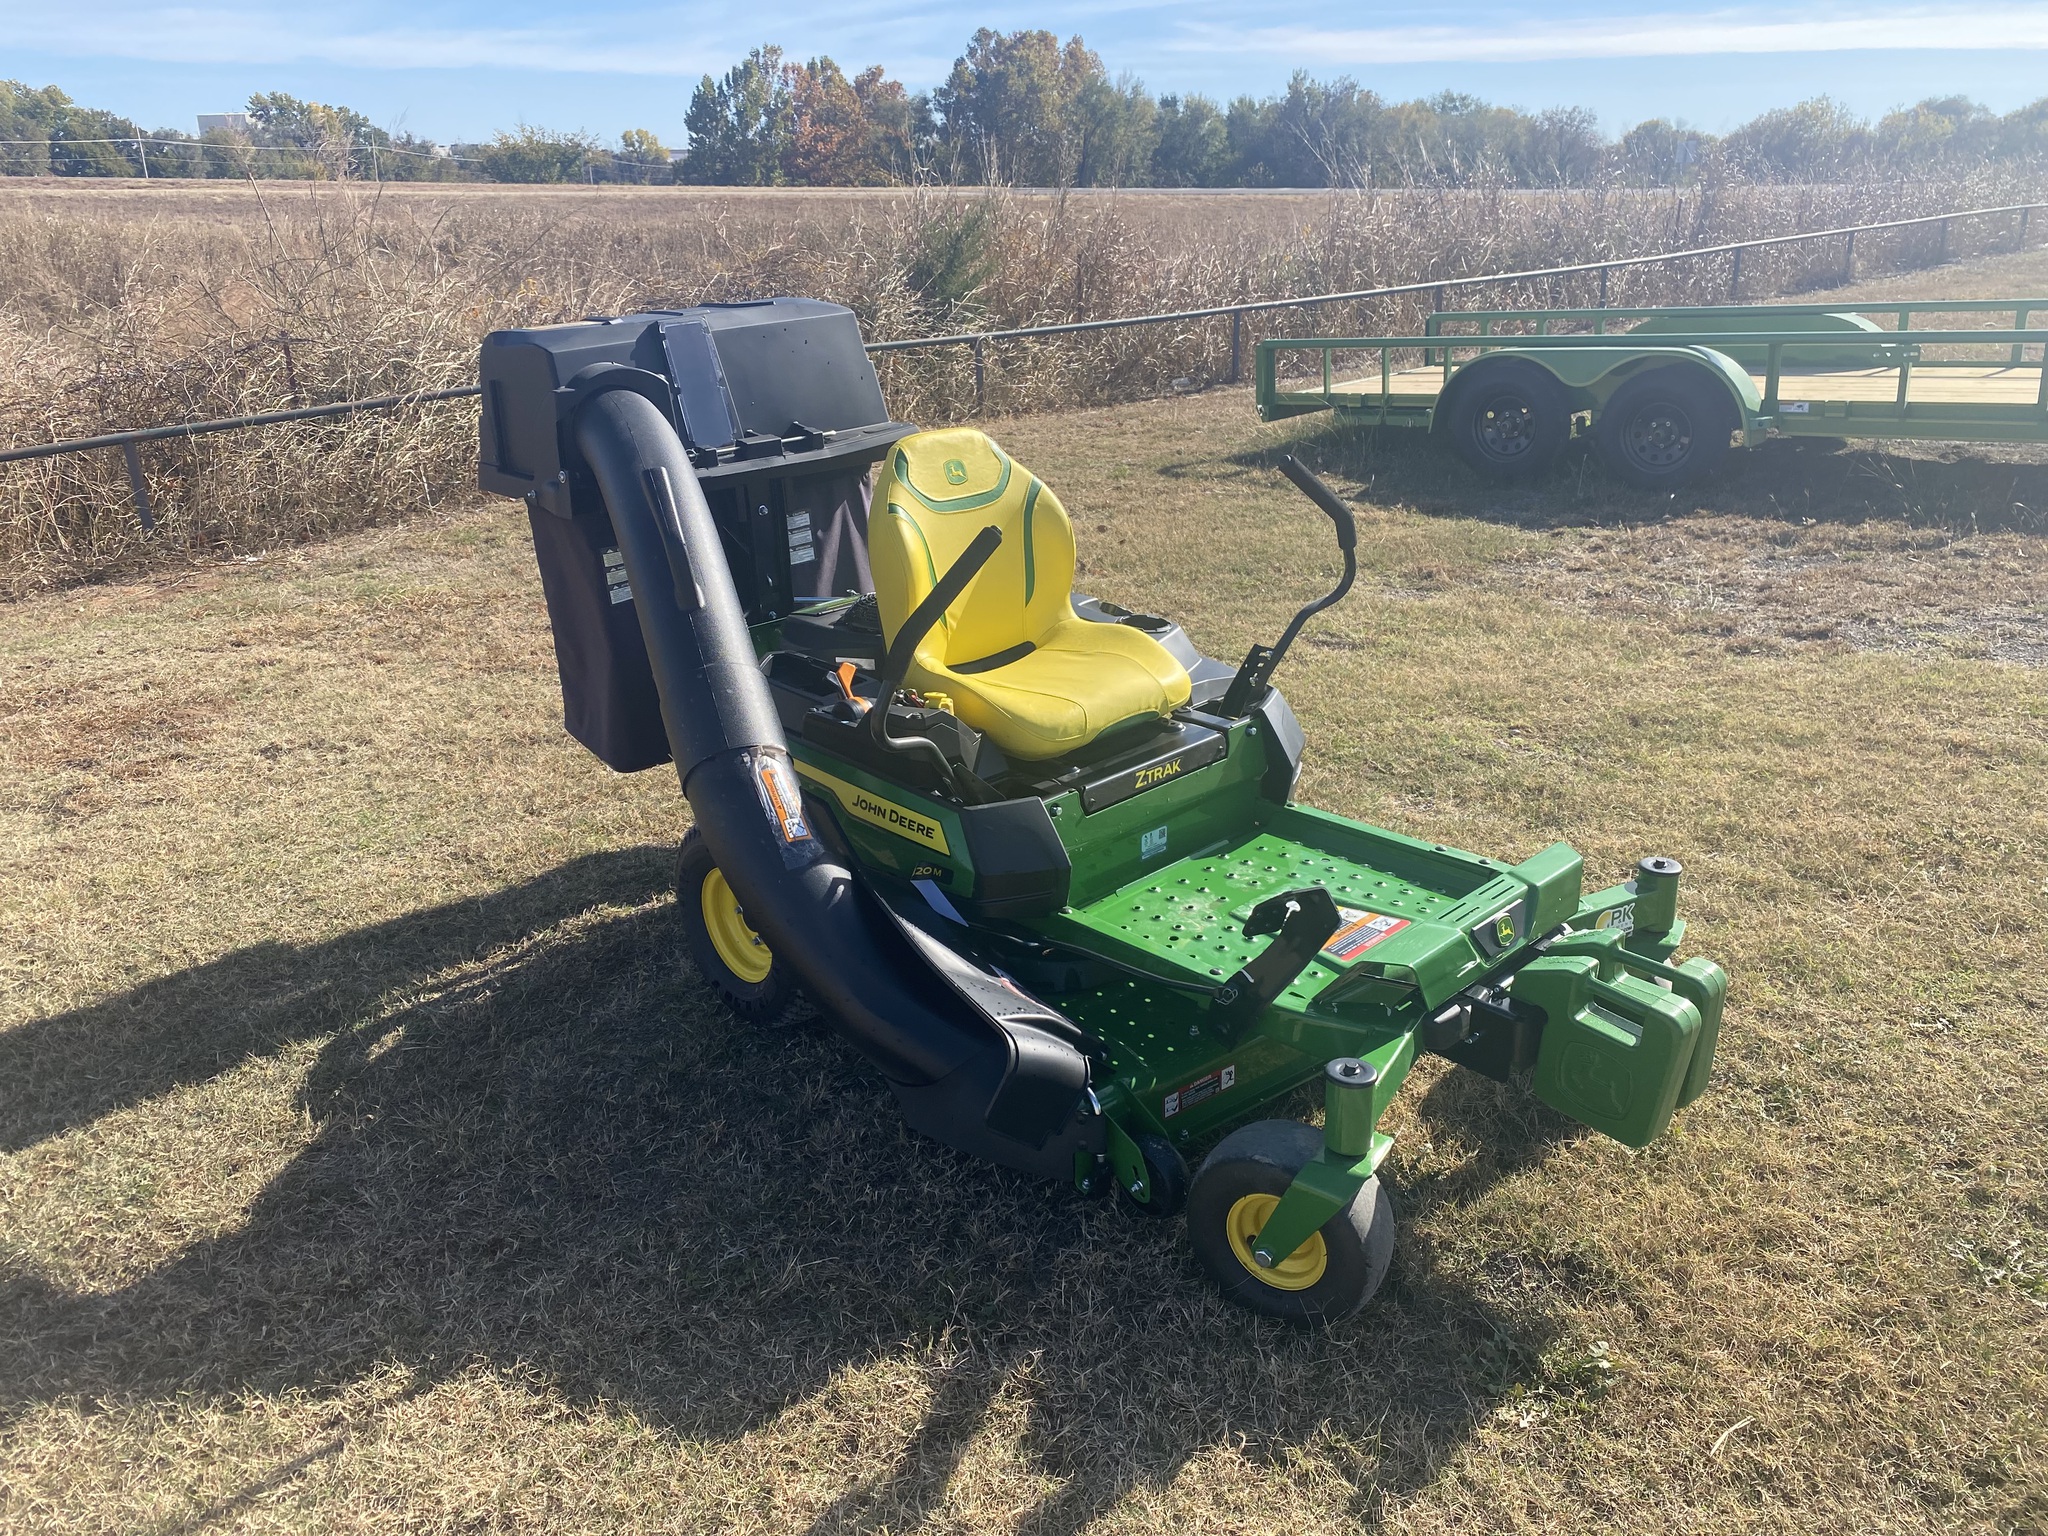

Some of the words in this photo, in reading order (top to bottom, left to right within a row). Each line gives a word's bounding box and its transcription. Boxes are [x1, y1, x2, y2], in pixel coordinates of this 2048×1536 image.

[1135, 759, 1181, 788] ZTRAK
[852, 795, 887, 819] JOHN
[889, 809, 935, 839] DEERE
